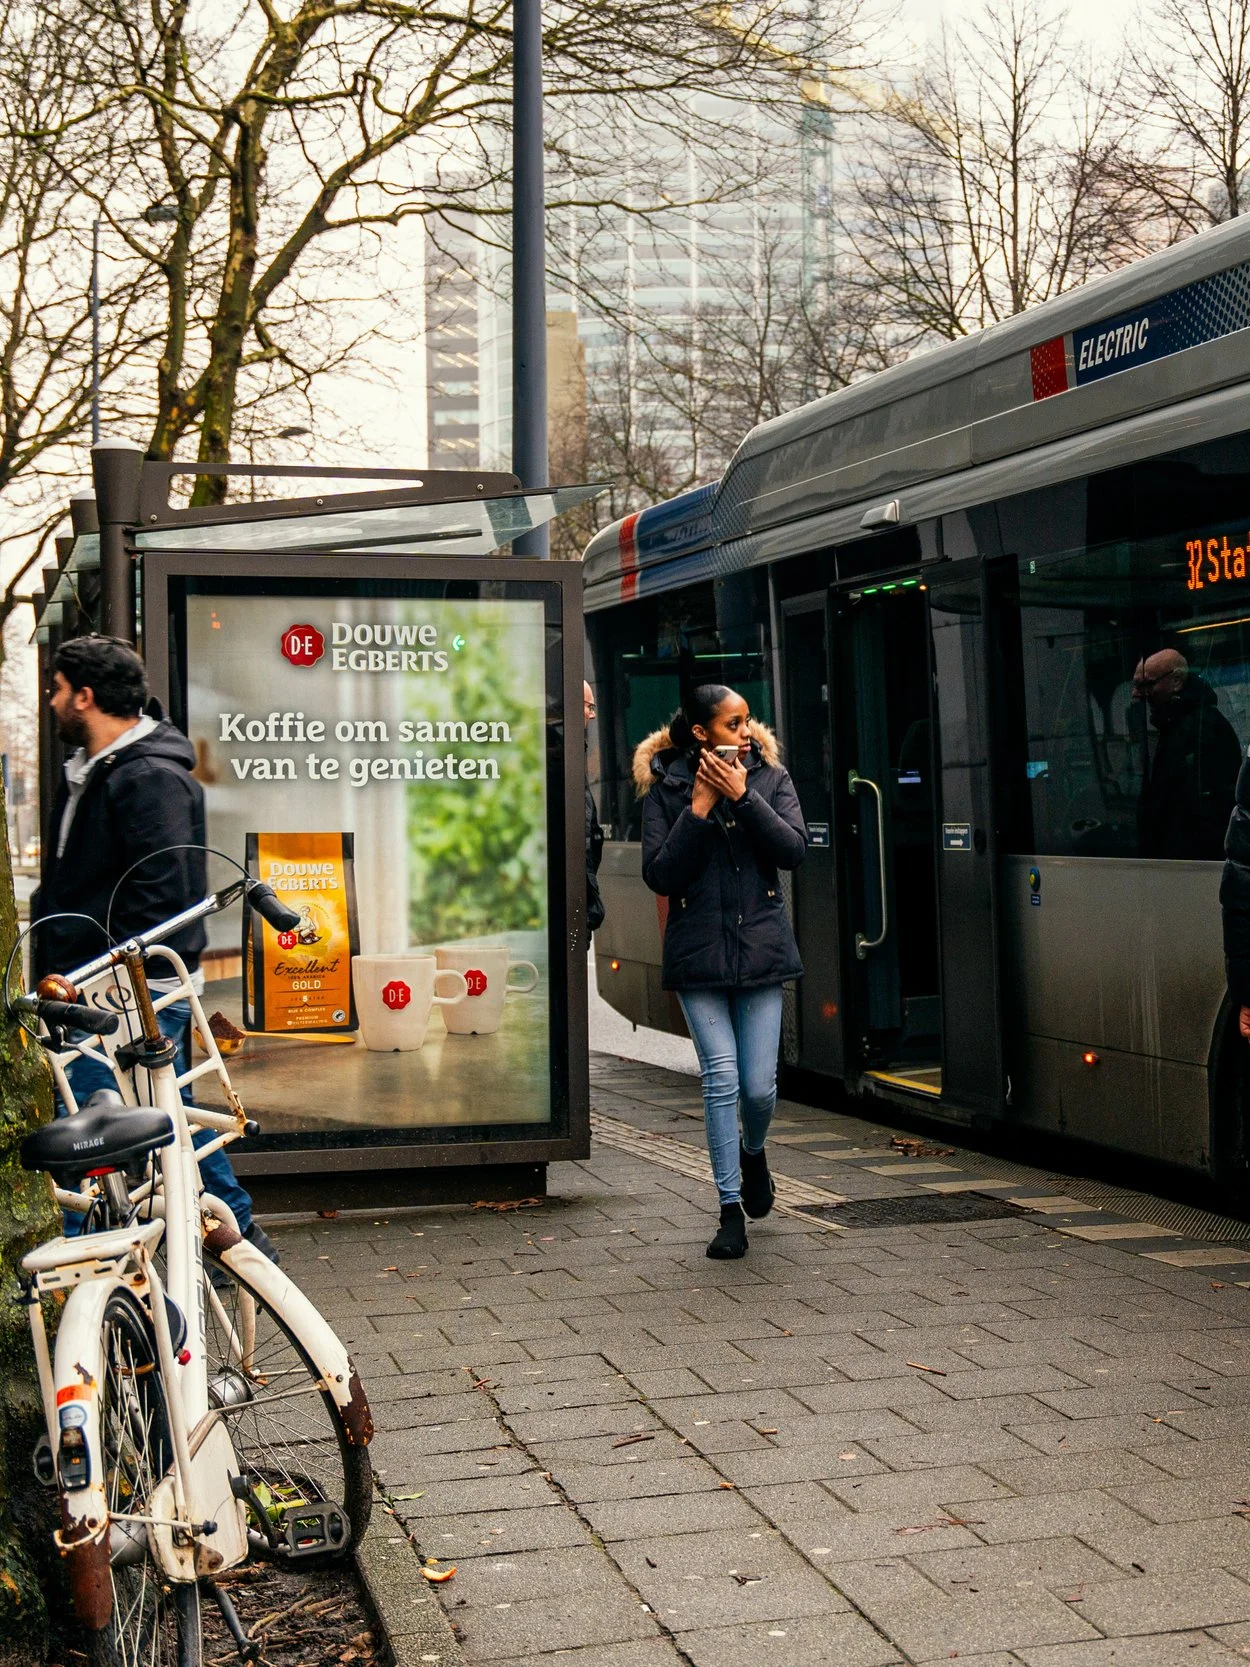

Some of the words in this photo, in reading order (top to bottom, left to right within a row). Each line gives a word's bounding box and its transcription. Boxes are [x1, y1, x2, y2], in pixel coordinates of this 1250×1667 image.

[1078, 317, 1149, 371] ELECTRIC
[331, 649, 449, 672] EGBERTS
[218, 712, 326, 743] Koffie
[334, 720, 389, 743] om
[398, 720, 512, 743] samen
[230, 757, 298, 780] van
[305, 753, 340, 780] te
[348, 750, 501, 787] genieten
[266, 877, 339, 891] EGBERTS
[274, 958, 340, 976] Excellent
[292, 980, 321, 990] GOLD
[73, 1136, 105, 1151] MIRAGE
